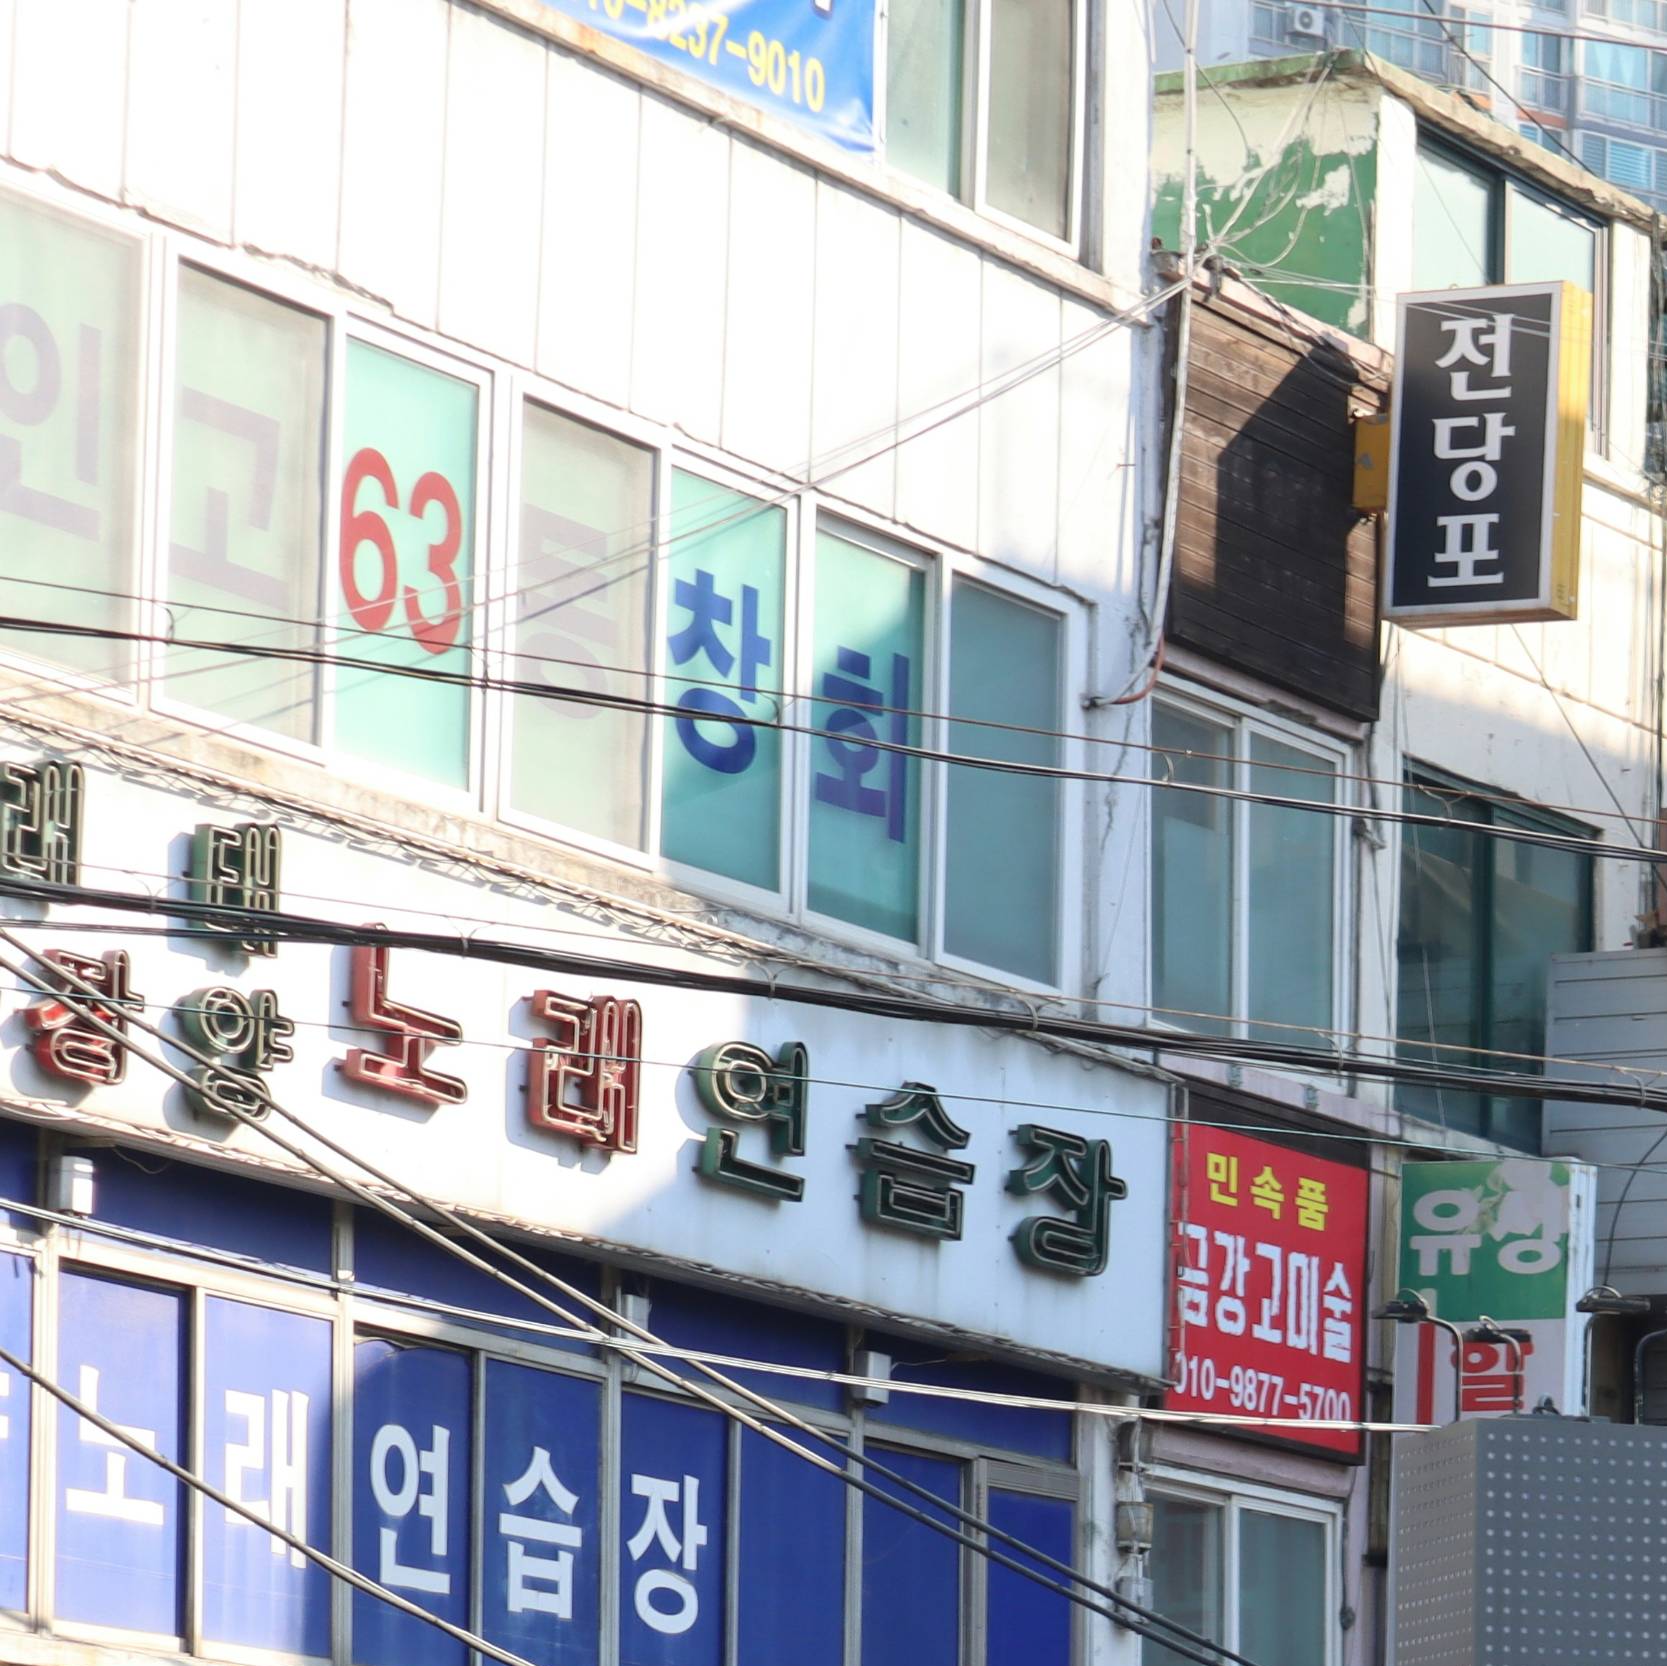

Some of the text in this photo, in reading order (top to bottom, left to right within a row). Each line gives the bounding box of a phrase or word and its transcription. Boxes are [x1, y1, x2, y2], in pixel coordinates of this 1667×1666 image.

[1427, 312, 1517, 588] 전당포
[339, 447, 463, 655] 63
[1205, 1150, 1329, 1231] 민속품
[1176, 1222, 1353, 1366] 금강고미술
[1174, 1350, 1352, 1425] 010-9877-5700
[64, 1364, 708, 1635] 노래연습장
